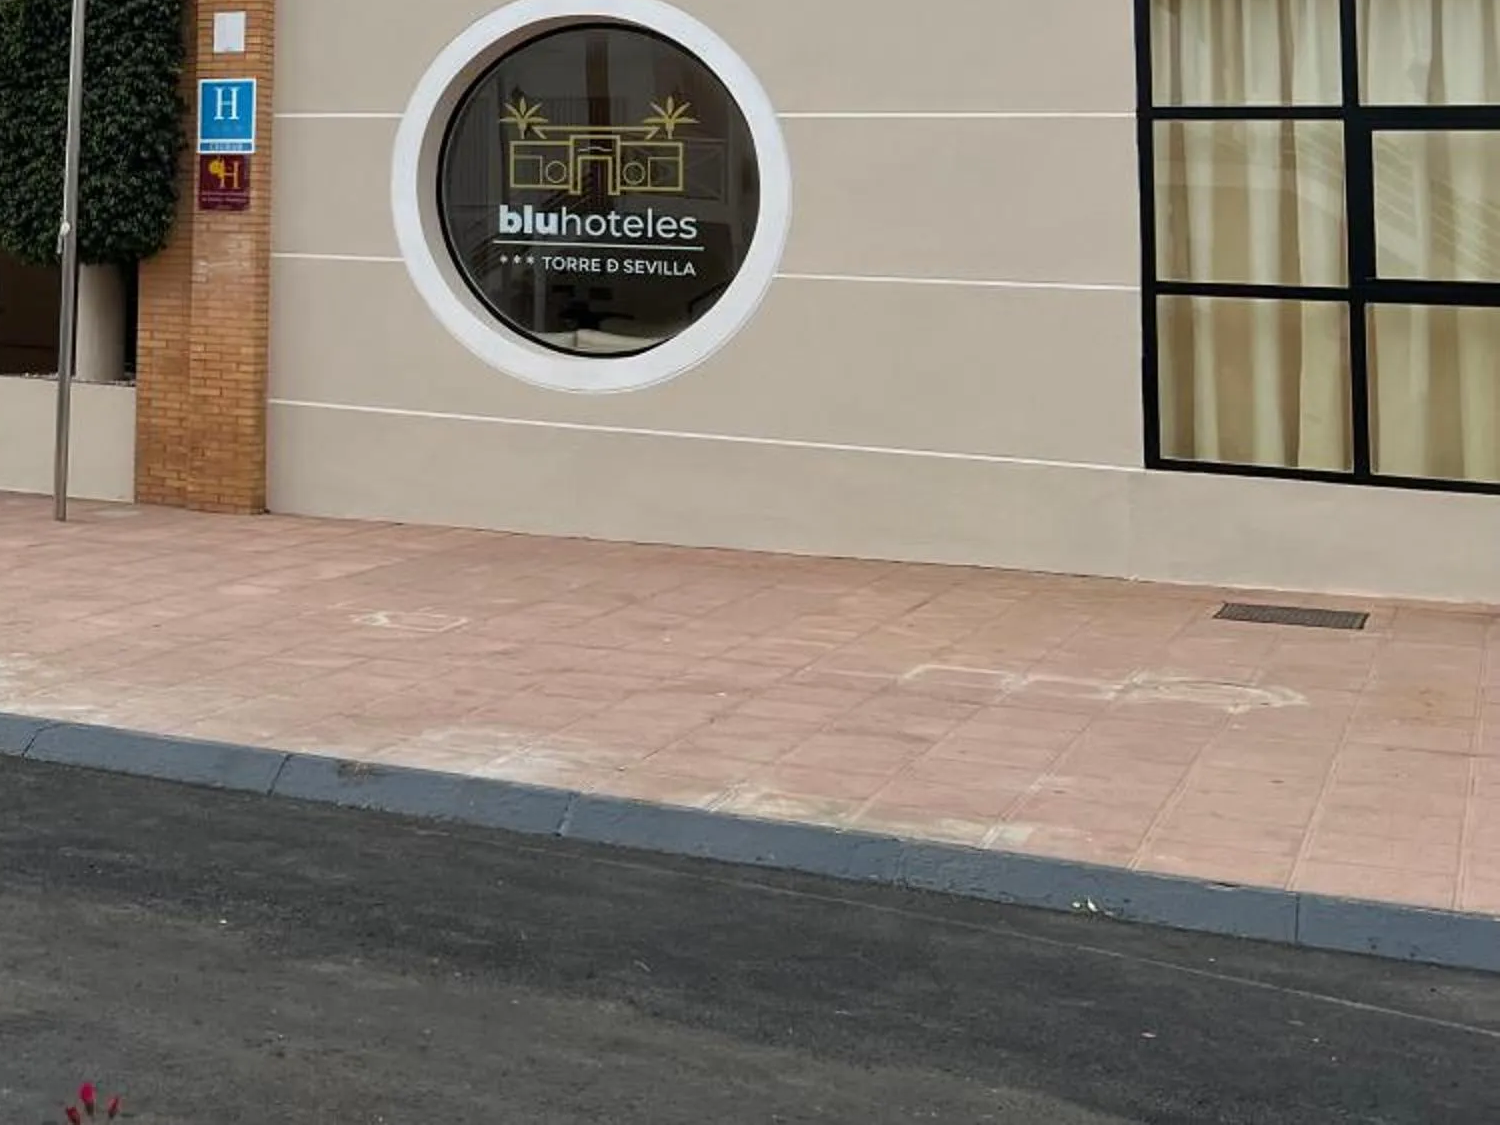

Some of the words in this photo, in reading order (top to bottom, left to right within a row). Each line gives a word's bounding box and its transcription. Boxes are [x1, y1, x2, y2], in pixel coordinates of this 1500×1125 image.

[214, 86, 241, 120] H
[499, 205, 697, 239] bluhoteles
[542, 256, 601, 272] TORRE
[623, 260, 697, 276] SEVILLA
